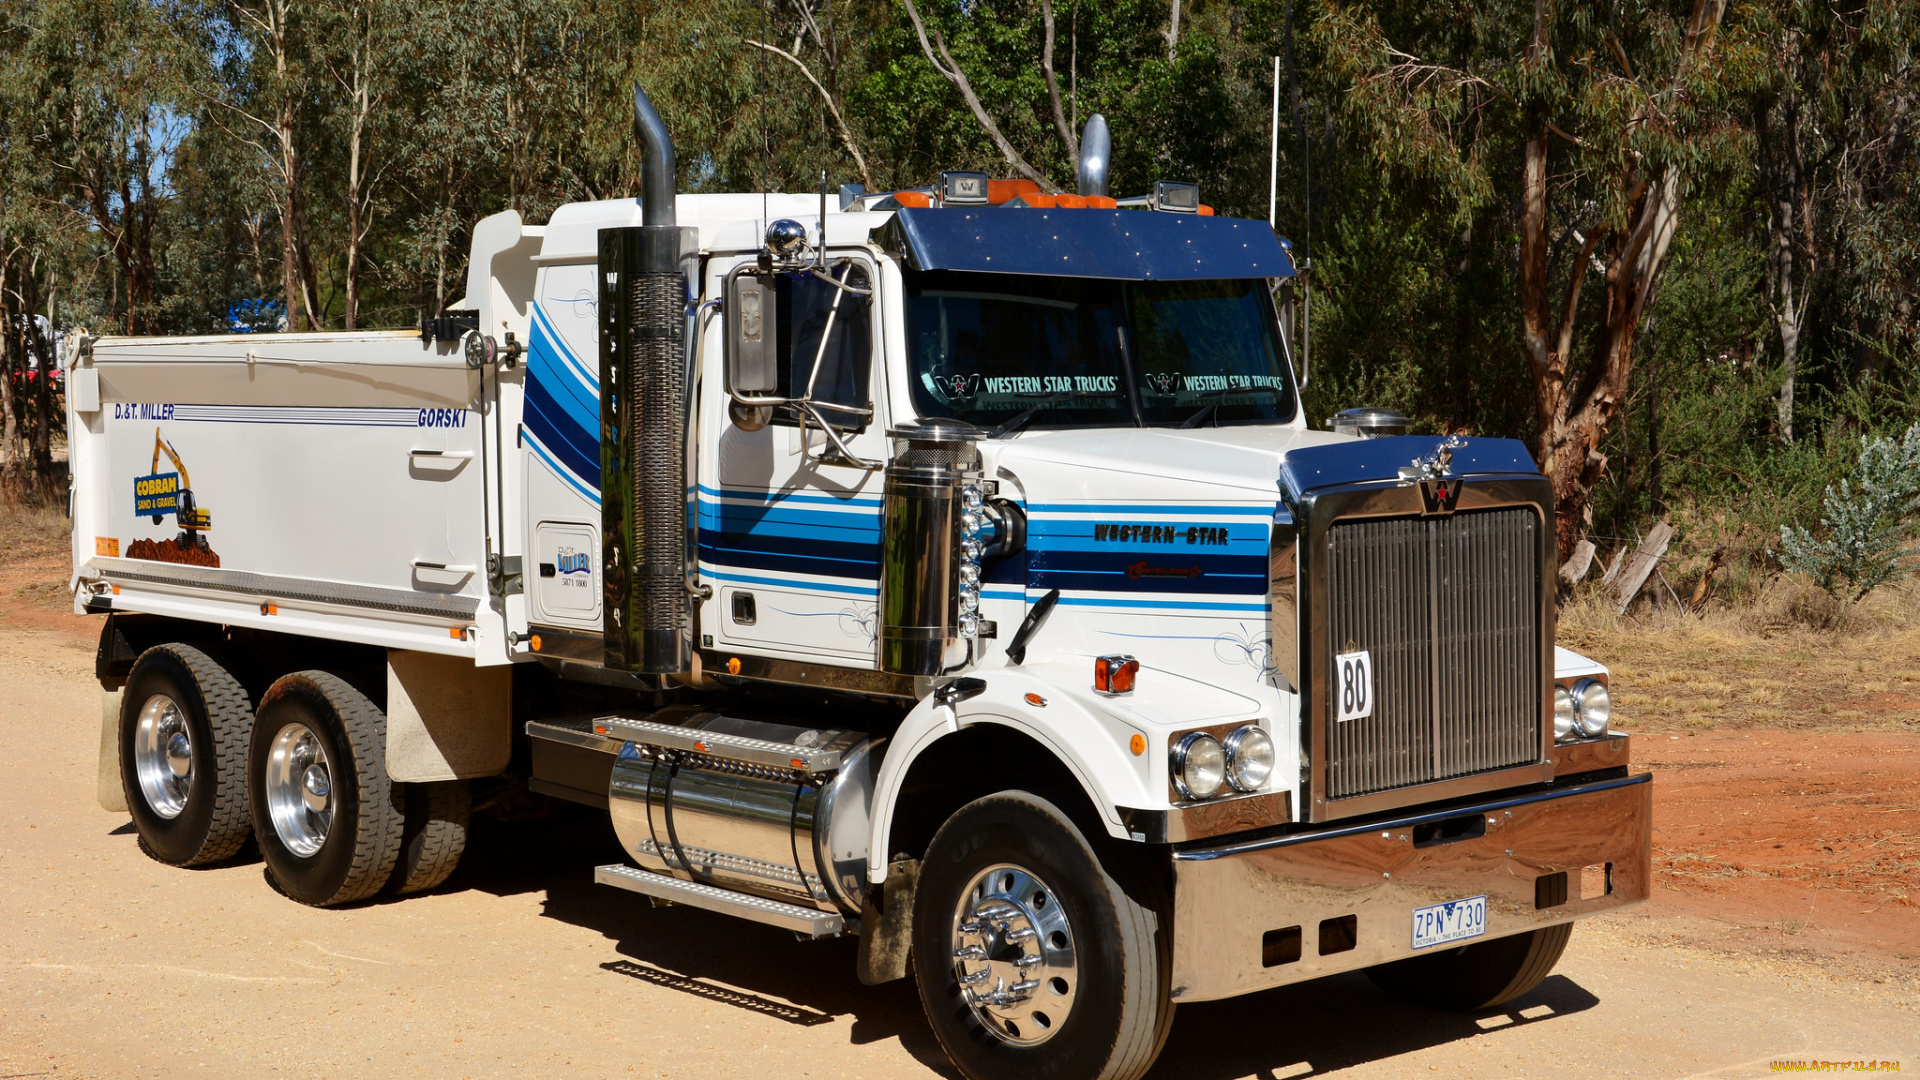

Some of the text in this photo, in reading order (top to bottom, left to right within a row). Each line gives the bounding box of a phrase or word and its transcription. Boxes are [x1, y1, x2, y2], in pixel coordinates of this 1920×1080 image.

[984, 375, 1116, 393] WESTERN STAR TRUCKS
[1183, 376, 1228, 391] WESTERN
[1229, 375, 1251, 389] STAR
[140, 403, 175, 420] MILLER
[418, 408, 467, 428] GORSKI
[136, 477, 177, 496] COBRAM
[137, 497, 177, 510] SAND & GRAVEL
[1094, 524, 1228, 545] WESTERN STAR
[558, 553, 590, 571] MILLER
[1343, 658, 1367, 715] 80
[1416, 903, 1483, 938] ZPN 730
[1415, 938, 1437, 946] VICTORIA
[1452, 930, 1467, 938] PLACE
